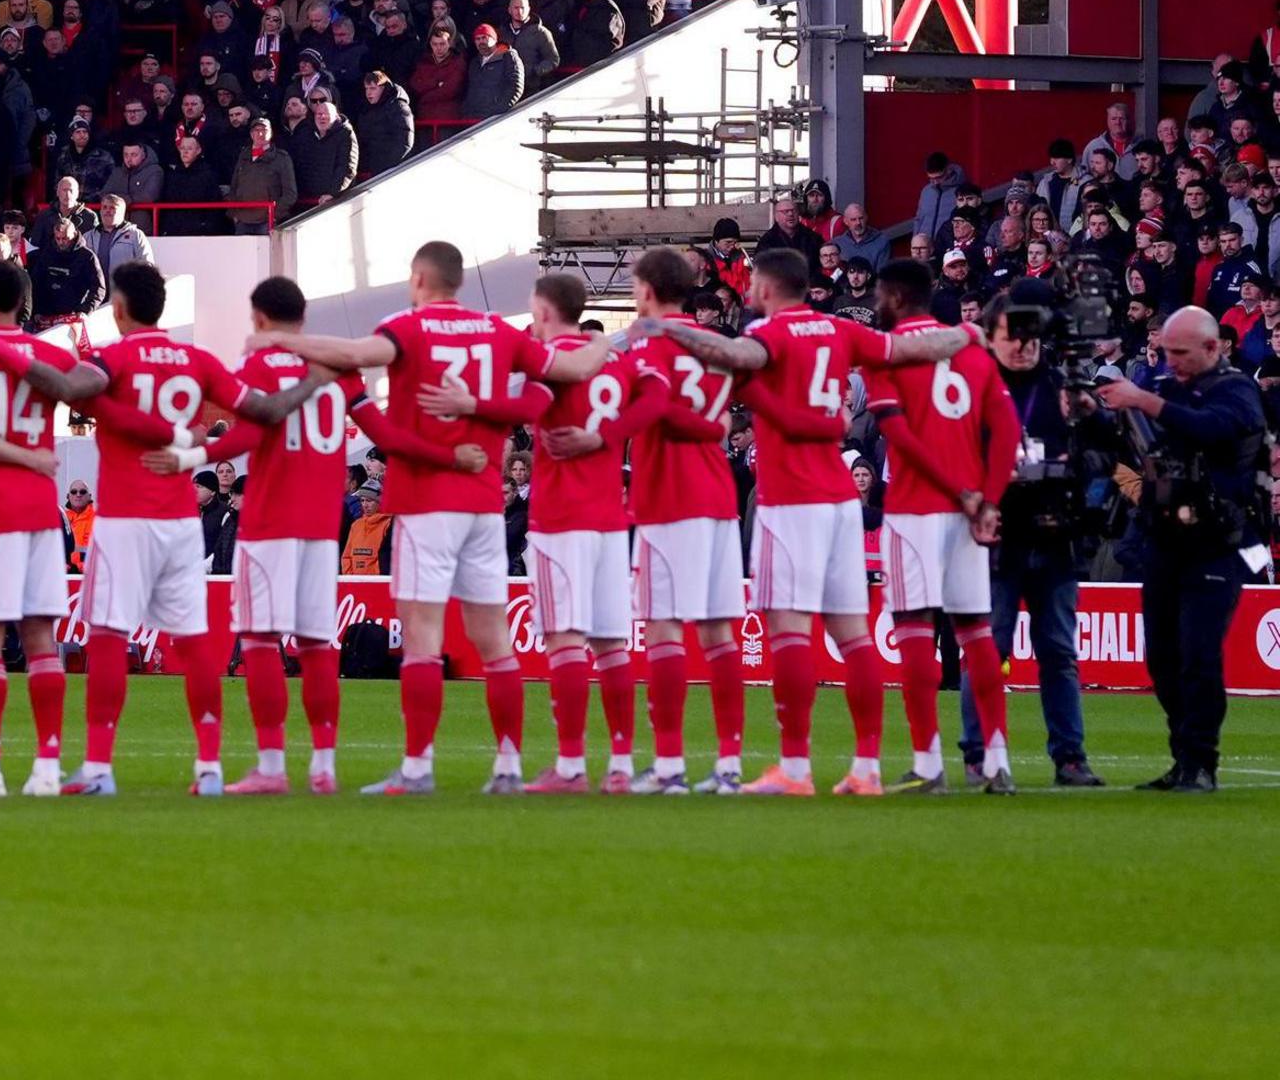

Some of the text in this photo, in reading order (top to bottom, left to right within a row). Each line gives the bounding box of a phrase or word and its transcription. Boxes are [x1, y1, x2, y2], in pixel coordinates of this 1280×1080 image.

[132, 373, 202, 427] 19
[585, 374, 623, 435] 8
[808, 347, 840, 417] 4
[931, 359, 971, 420] 6
[278, 377, 347, 454] 10
